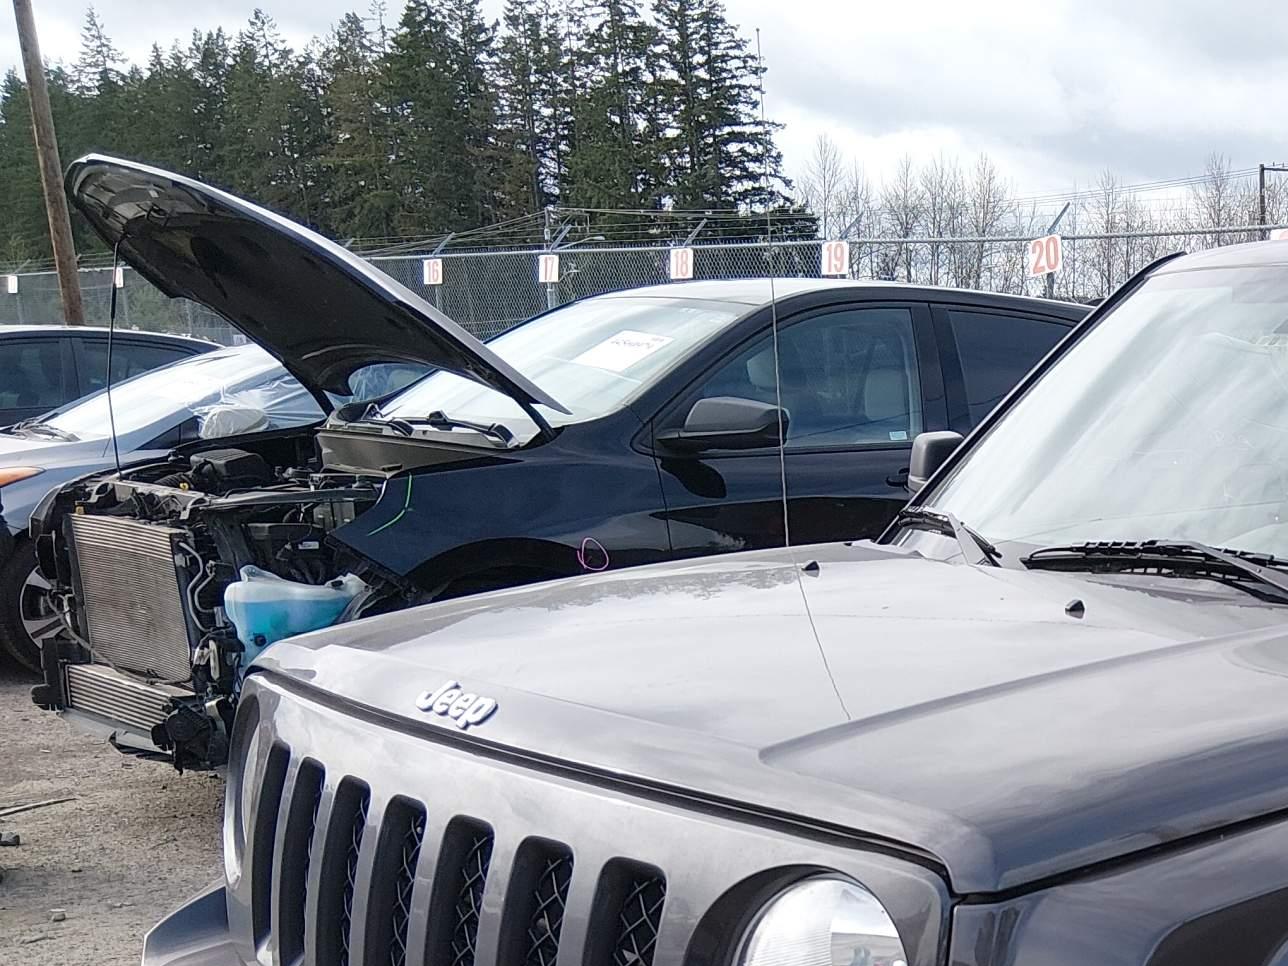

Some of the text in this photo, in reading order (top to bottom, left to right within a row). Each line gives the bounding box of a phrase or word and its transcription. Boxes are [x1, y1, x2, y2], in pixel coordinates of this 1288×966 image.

[543, 256, 555, 281] 17
[673, 250, 689, 277] 18
[826, 243, 845, 273] 19
[1031, 236, 1060, 275] 20
[426, 262, 440, 283] 16
[415, 680, 498, 730] Jeep
